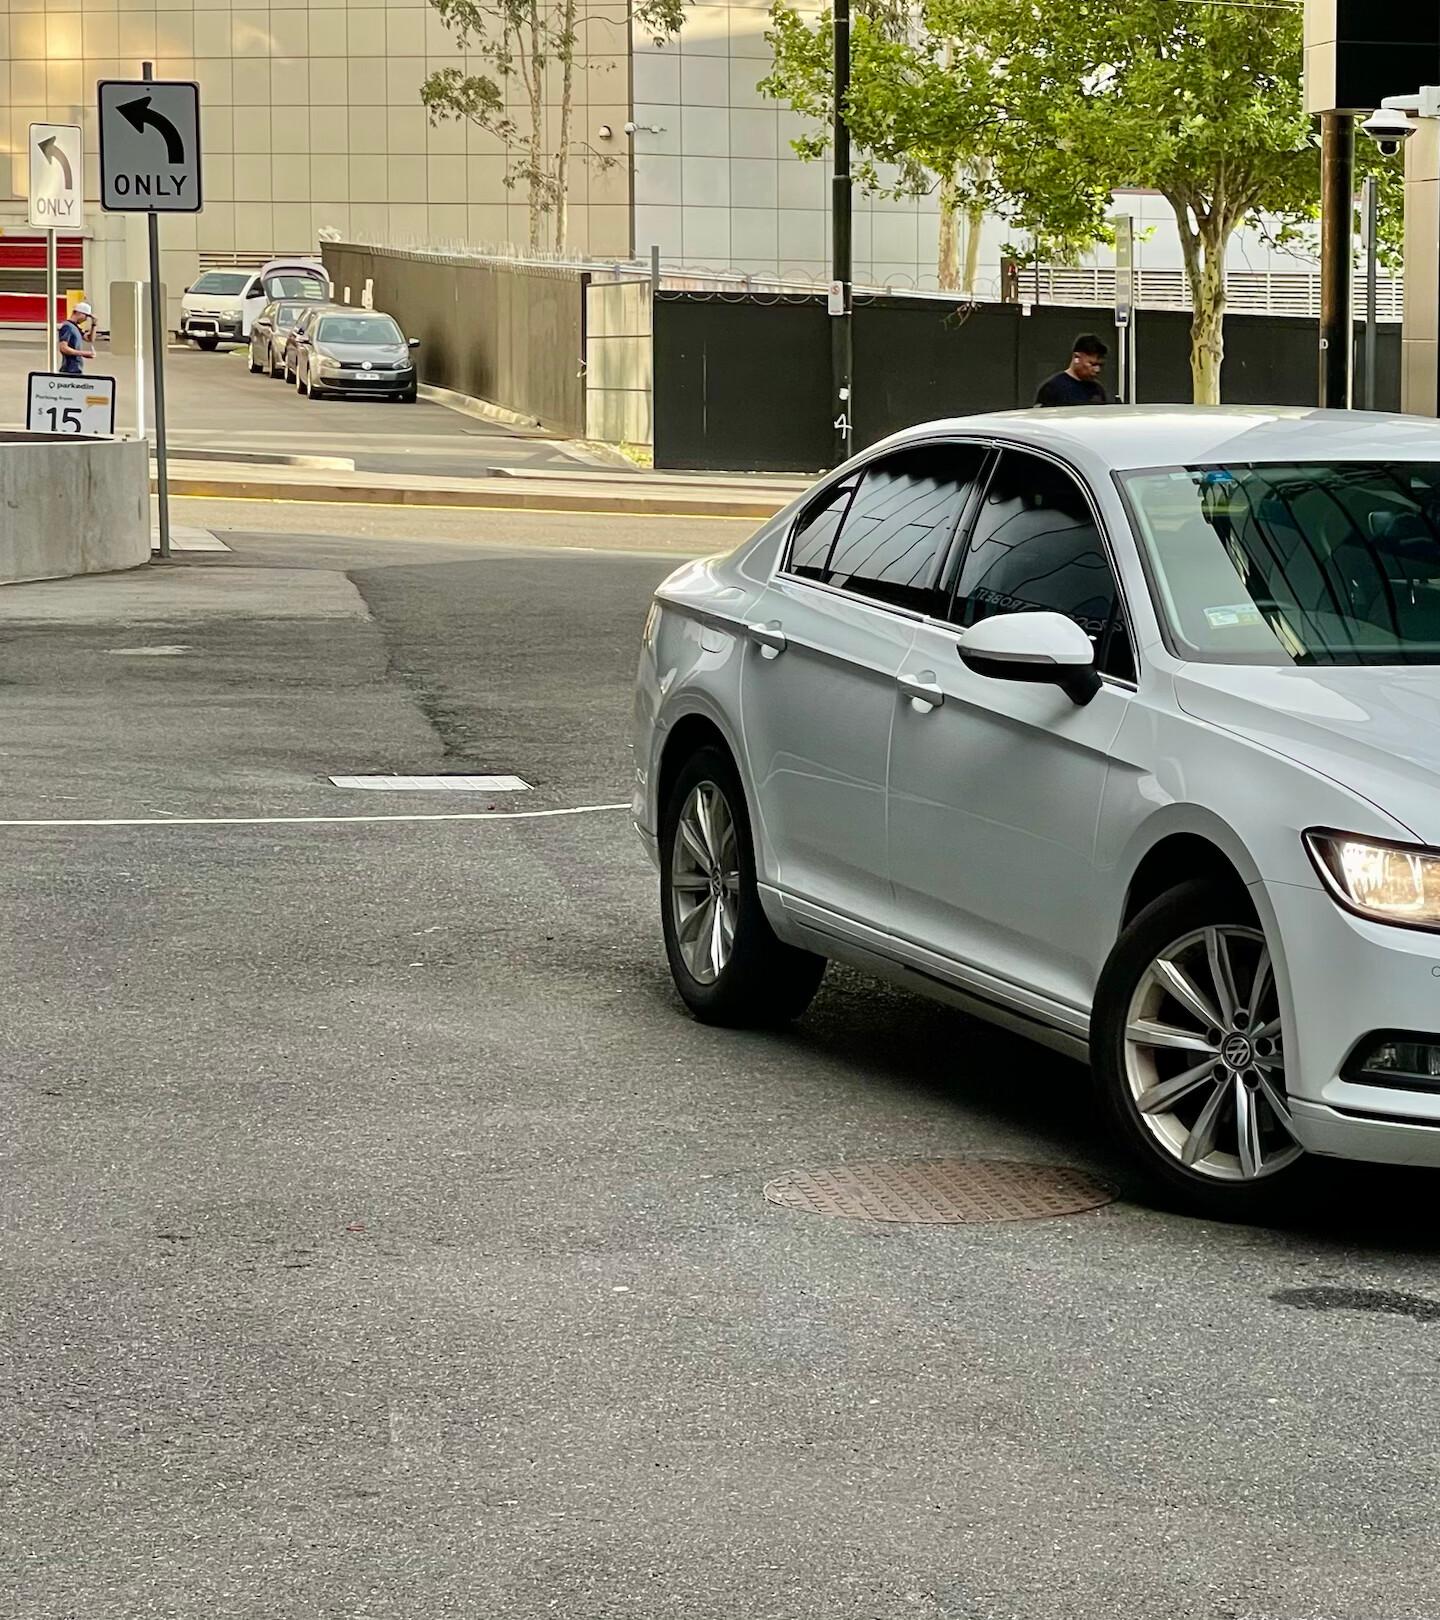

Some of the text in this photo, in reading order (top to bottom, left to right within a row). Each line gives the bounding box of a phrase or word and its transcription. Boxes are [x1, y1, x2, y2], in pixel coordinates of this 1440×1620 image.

[114, 174, 187, 197] ONLY
[36, 198, 74, 217] ONLY
[833, 413, 853, 439] 4
